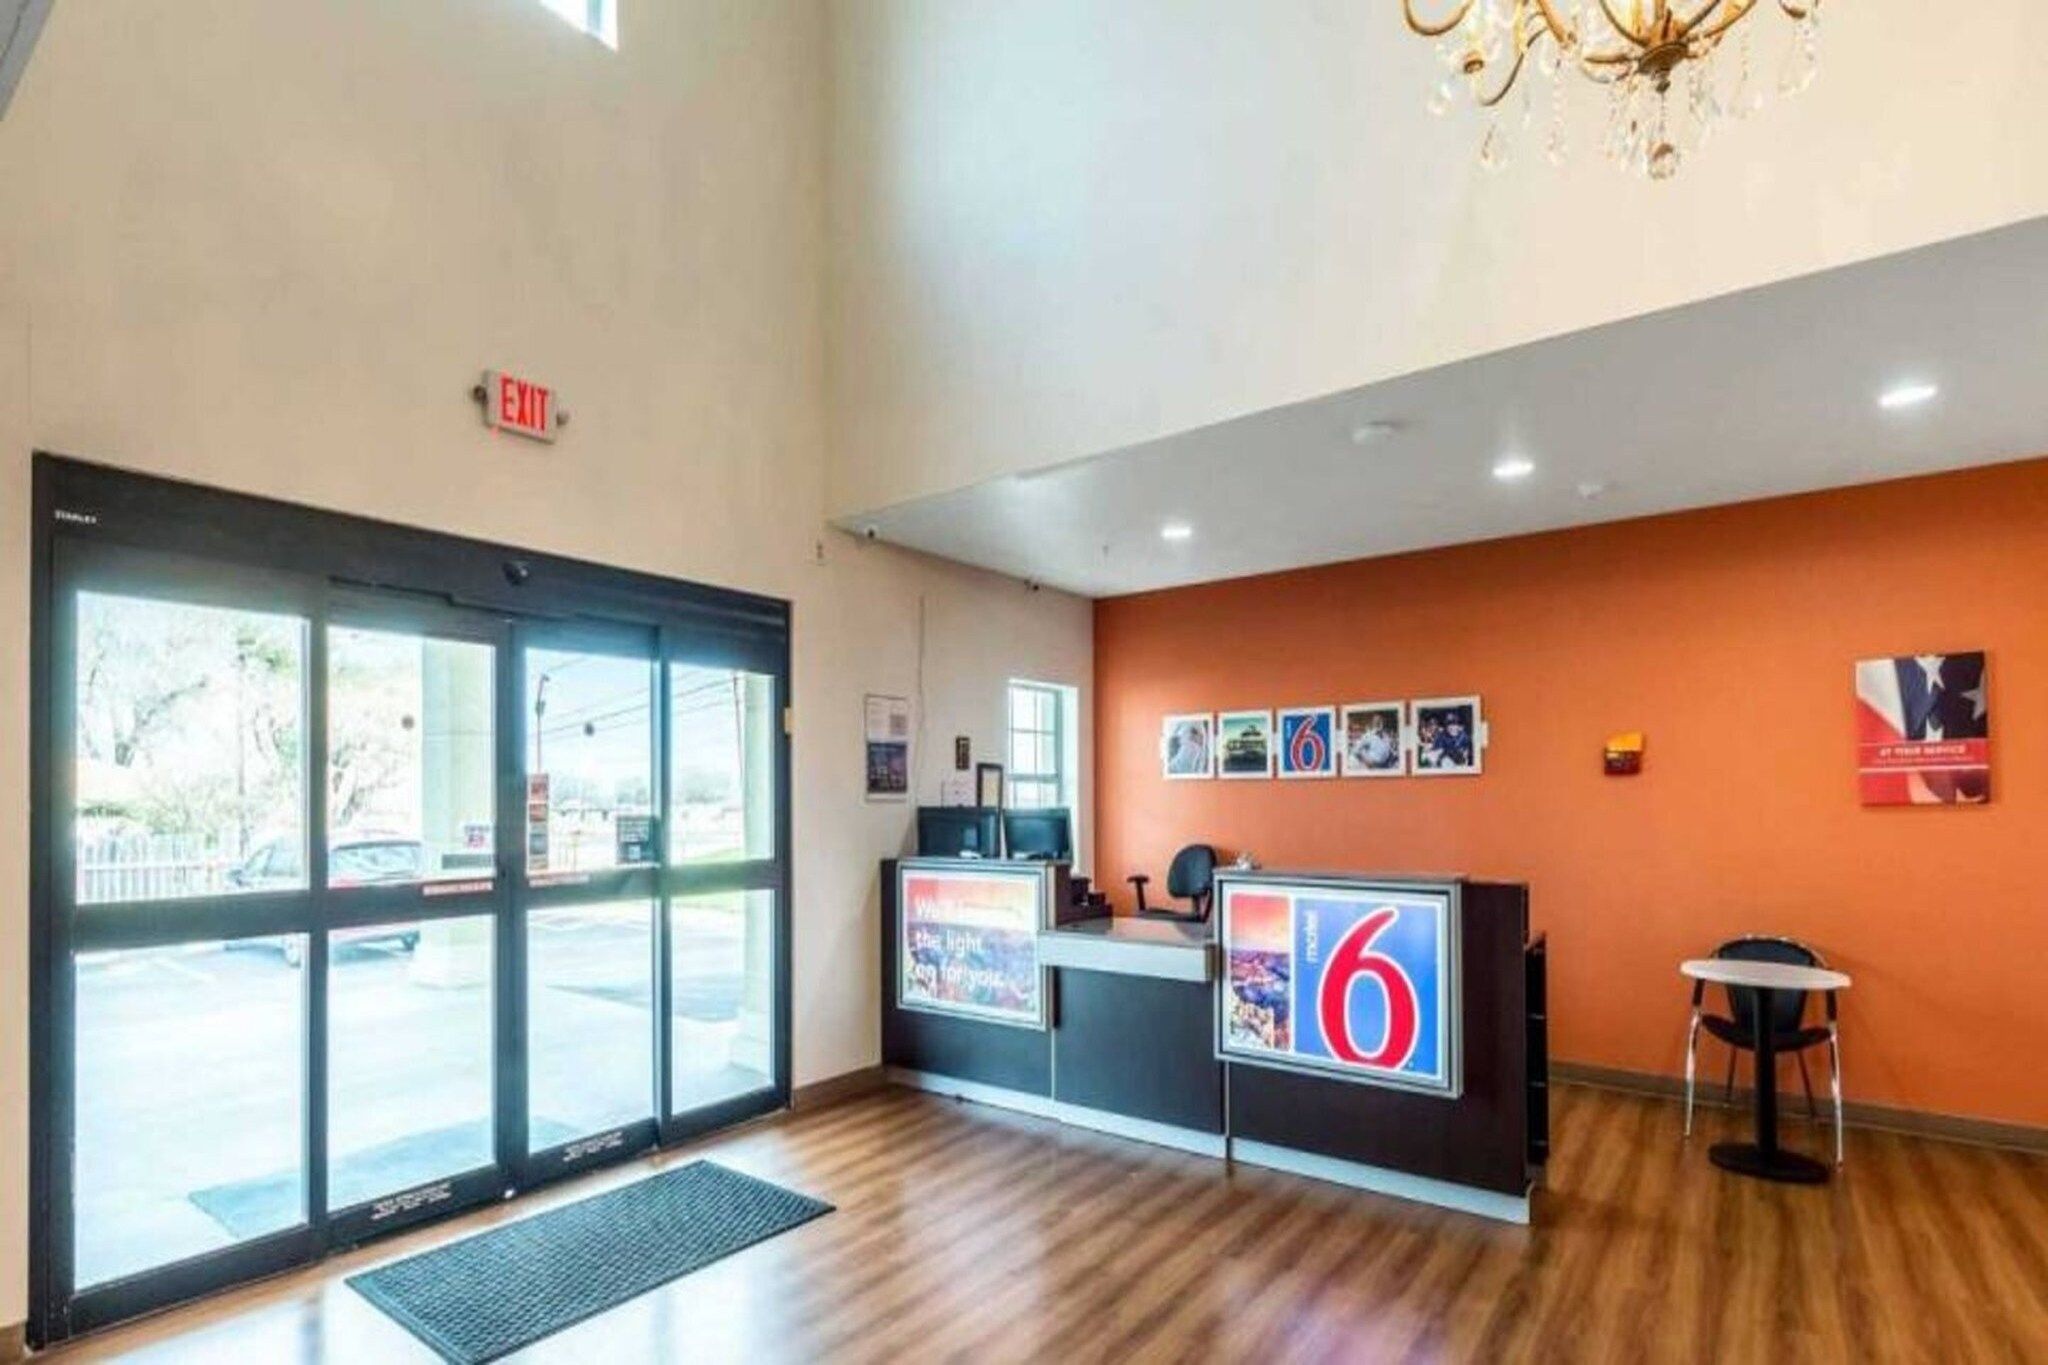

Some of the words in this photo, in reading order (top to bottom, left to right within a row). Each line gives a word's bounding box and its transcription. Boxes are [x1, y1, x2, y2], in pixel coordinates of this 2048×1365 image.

[500, 377, 548, 431] EXIT
[1290, 716, 1325, 771] 6
[916, 928, 942, 951] the
[947, 929, 983, 958] light
[1305, 909, 1319, 963] motel
[1316, 906, 1421, 1071] 6
